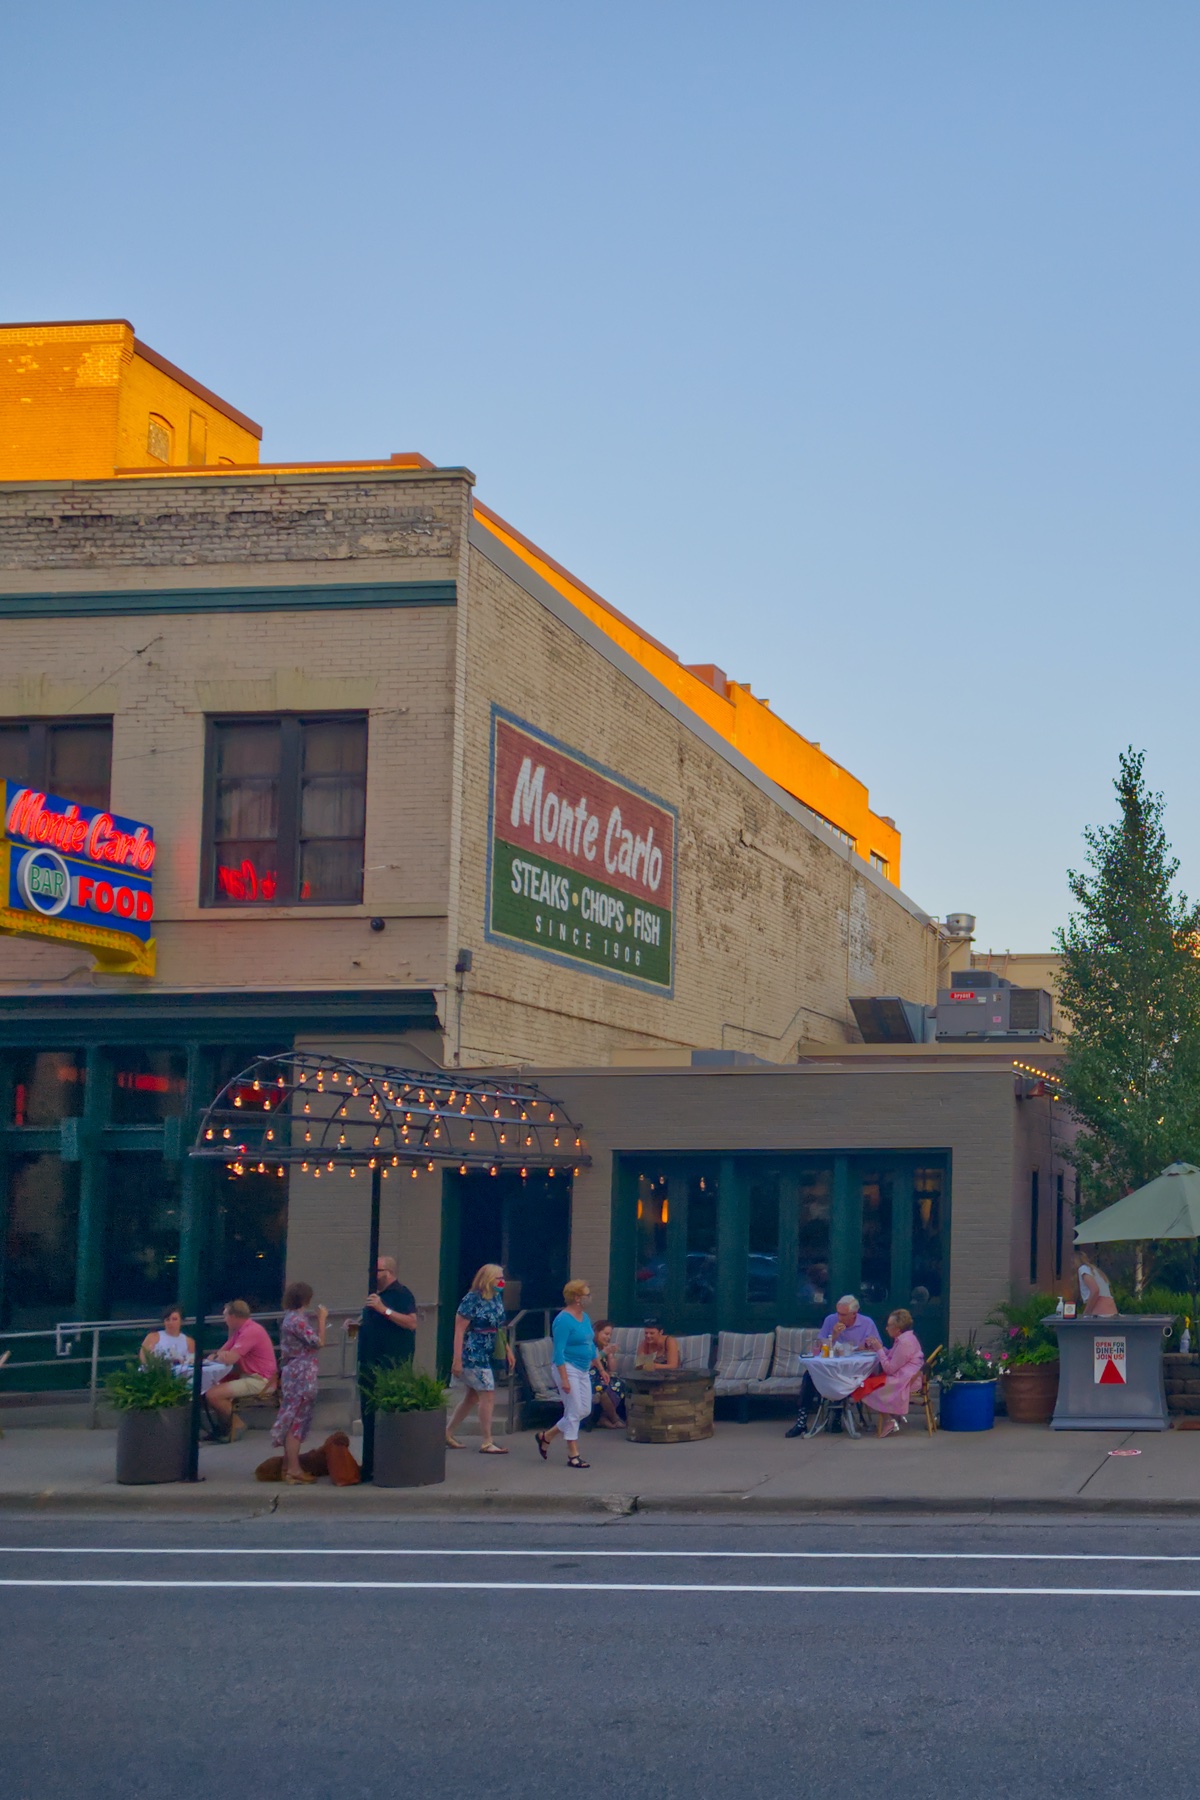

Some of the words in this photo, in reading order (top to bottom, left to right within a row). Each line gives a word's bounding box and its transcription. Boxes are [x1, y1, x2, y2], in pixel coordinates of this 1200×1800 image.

[7, 789, 88, 851] Monte
[85, 813, 155, 871] Carlo
[510, 756, 599, 861] Monte
[604, 806, 663, 891] Carlo
[30, 864, 64, 897] BAR
[72, 876, 154, 921] FOOD
[511, 858, 569, 911] STEAKS
[581, 886, 624, 933] CHOPS
[634, 907, 660, 946] FISH
[535, 915, 591, 950] SINCE
[603, 938, 641, 966] 1906
